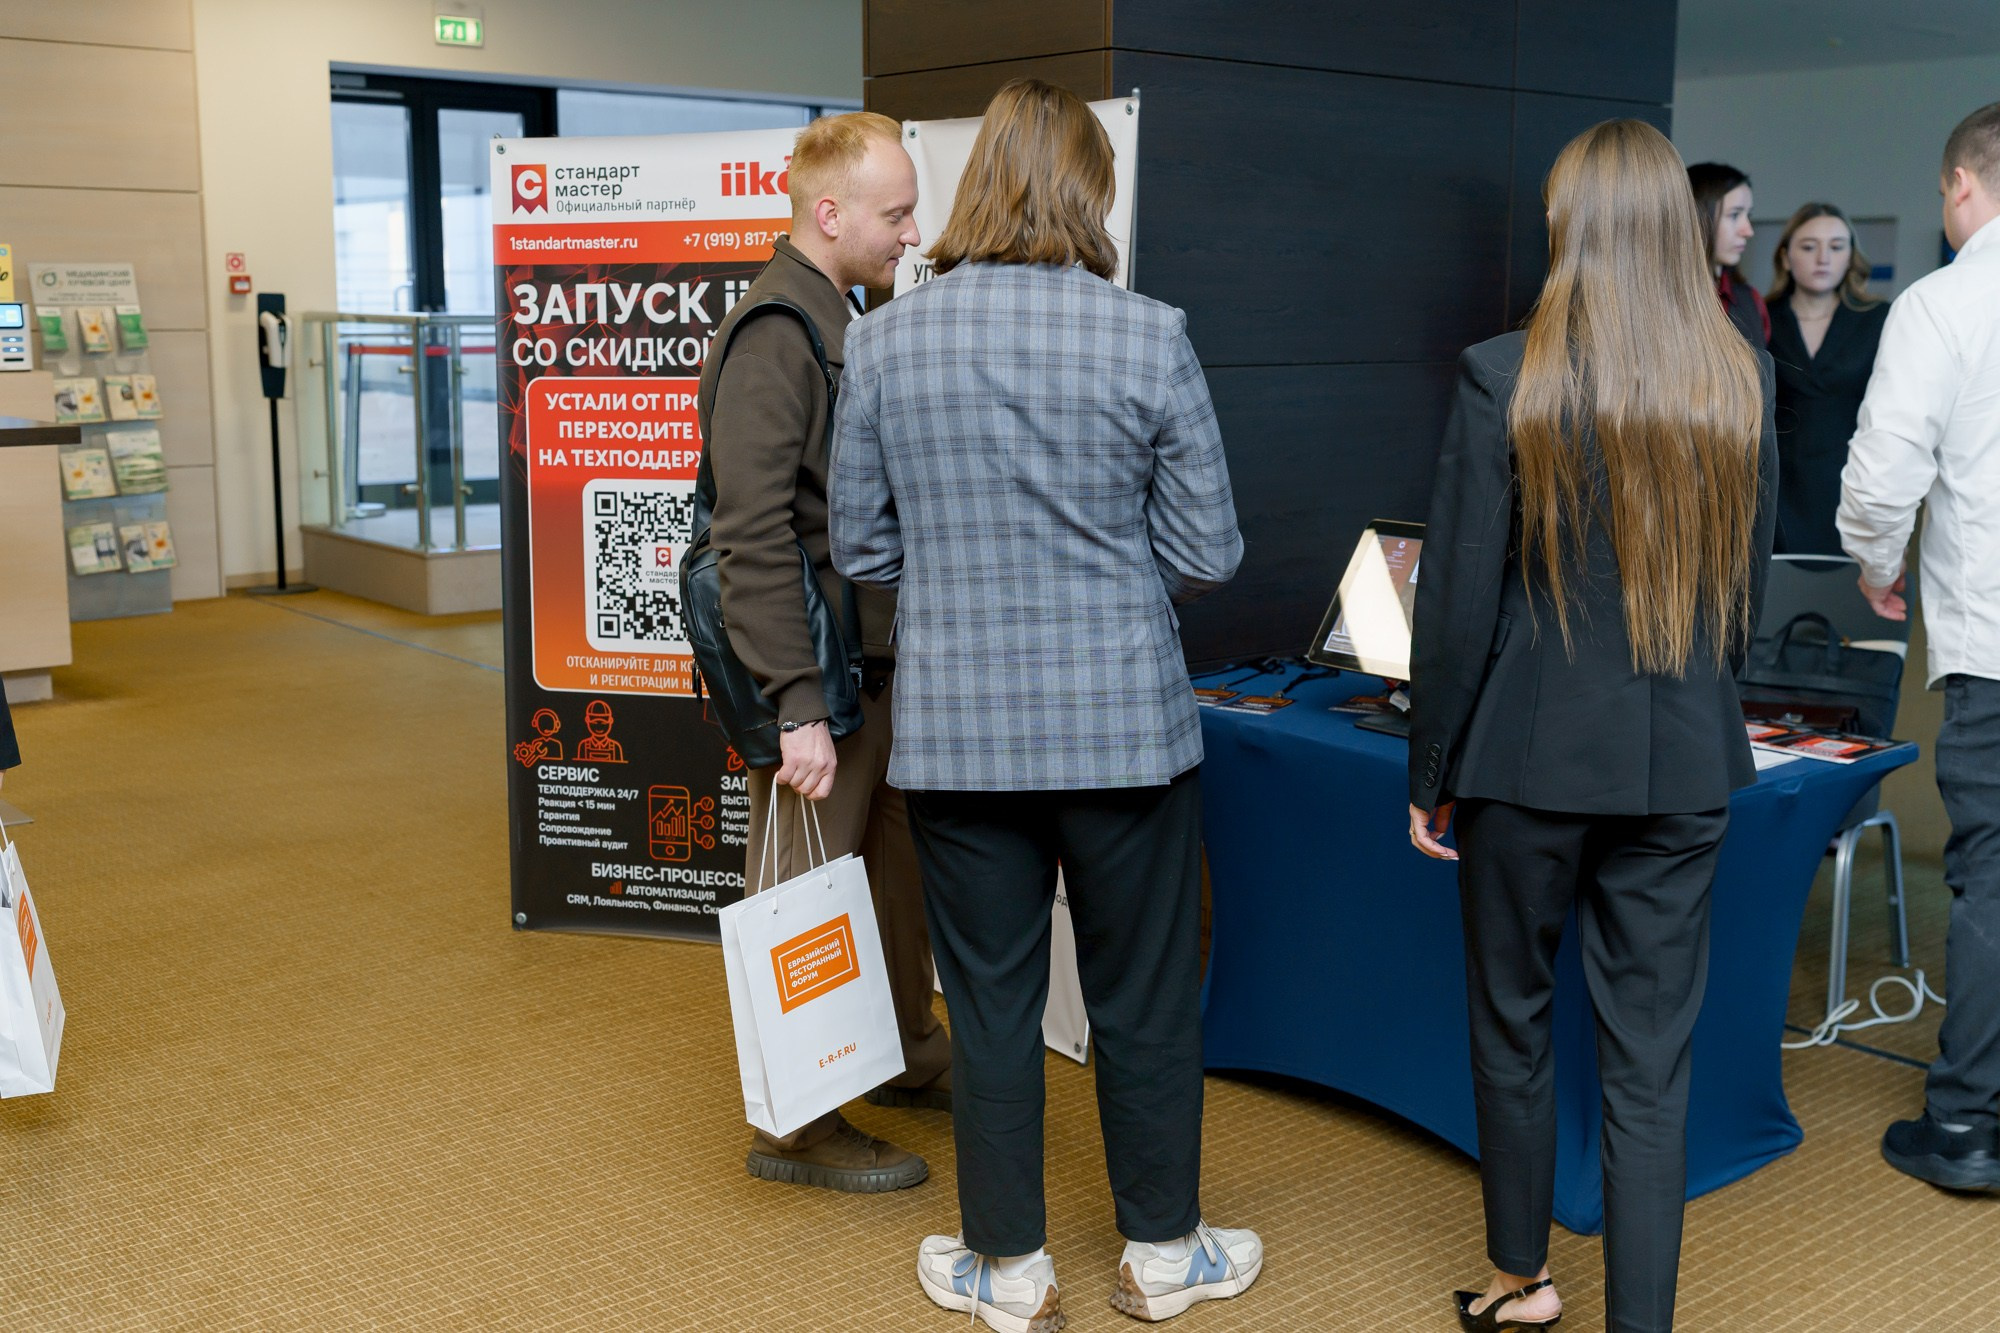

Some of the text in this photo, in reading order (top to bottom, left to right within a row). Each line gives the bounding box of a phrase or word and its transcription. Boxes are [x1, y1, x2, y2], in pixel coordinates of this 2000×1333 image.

[555, 164, 641, 181] стандарт
[555, 182, 623, 200] мастер
[556, 197, 696, 214] Официальный партнёр
[508, 235, 639, 251] 1standartmaster.ru
[683, 230, 788, 250] +7 (919) 817-1
[512, 281, 713, 325] ЗАПУСК
[512, 337, 557, 367] СО
[545, 392, 627, 411] УСТАЛИ
[631, 393, 661, 411] ОТ
[559, 421, 693, 442] ПЕРЕХОДИТЕ
[538, 448, 568, 466] НА
[566, 655, 650, 671] ОТСКАНИРУЙТЕ
[653, 659, 677, 672] ДЛЯ
[590, 674, 598, 685] И
[601, 674, 679, 690] РЕГИСТРАЦИИ
[538, 765, 600, 783] СЕРВИС
[538, 784, 639, 801] ТЕХПОДДЕРЖКА 24/7
[720, 795, 751, 806] БЫСТ
[538, 797, 576, 809] Реакция
[585, 800, 595, 809] 15
[596, 802, 616, 810] мин
[538, 810, 580, 821] Гарантия
[539, 822, 612, 836] Сопровождение
[539, 835, 628, 850] Проактивный аудит
[625, 885, 716, 901] АВТОМАТИЗАЦИЯ
[566, 894, 592, 906] CRM,
[593, 896, 651, 911] Лояльность,
[653, 901, 701, 915] Финансы,
[787, 938, 840, 970] ЕВРАЗИЙСКИЙ
[789, 948, 842, 979] РЕСТОРАННЫЙ
[791, 970, 819, 988] ФОРУМ
[818, 1042, 857, 1068] E-R-F.RU
